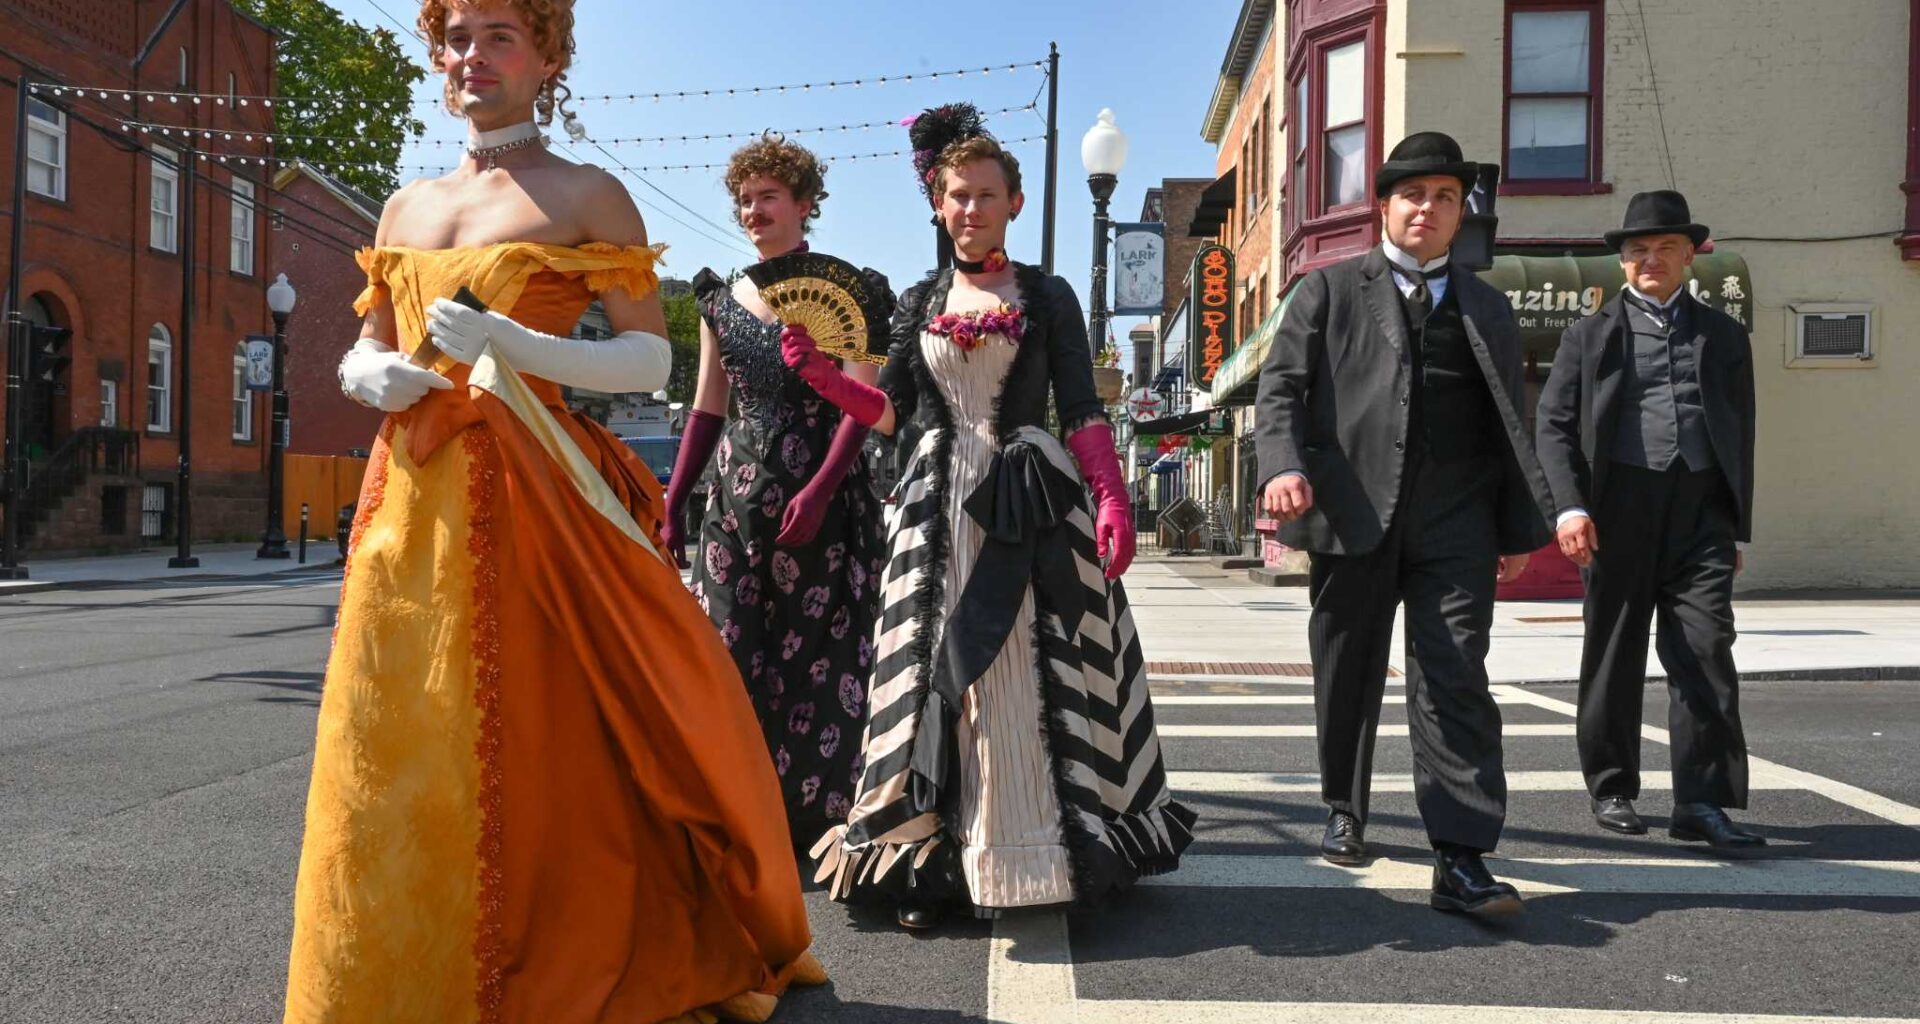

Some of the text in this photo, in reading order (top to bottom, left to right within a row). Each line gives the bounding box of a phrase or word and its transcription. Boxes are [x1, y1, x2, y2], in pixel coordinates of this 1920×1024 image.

[1120, 249, 1157, 261] LARK
[1504, 282, 1604, 316] azing
[1202, 250, 1228, 381] SOHO PIZZA
[1519, 316, 1537, 328] Out
[1544, 317, 1566, 328] Free
